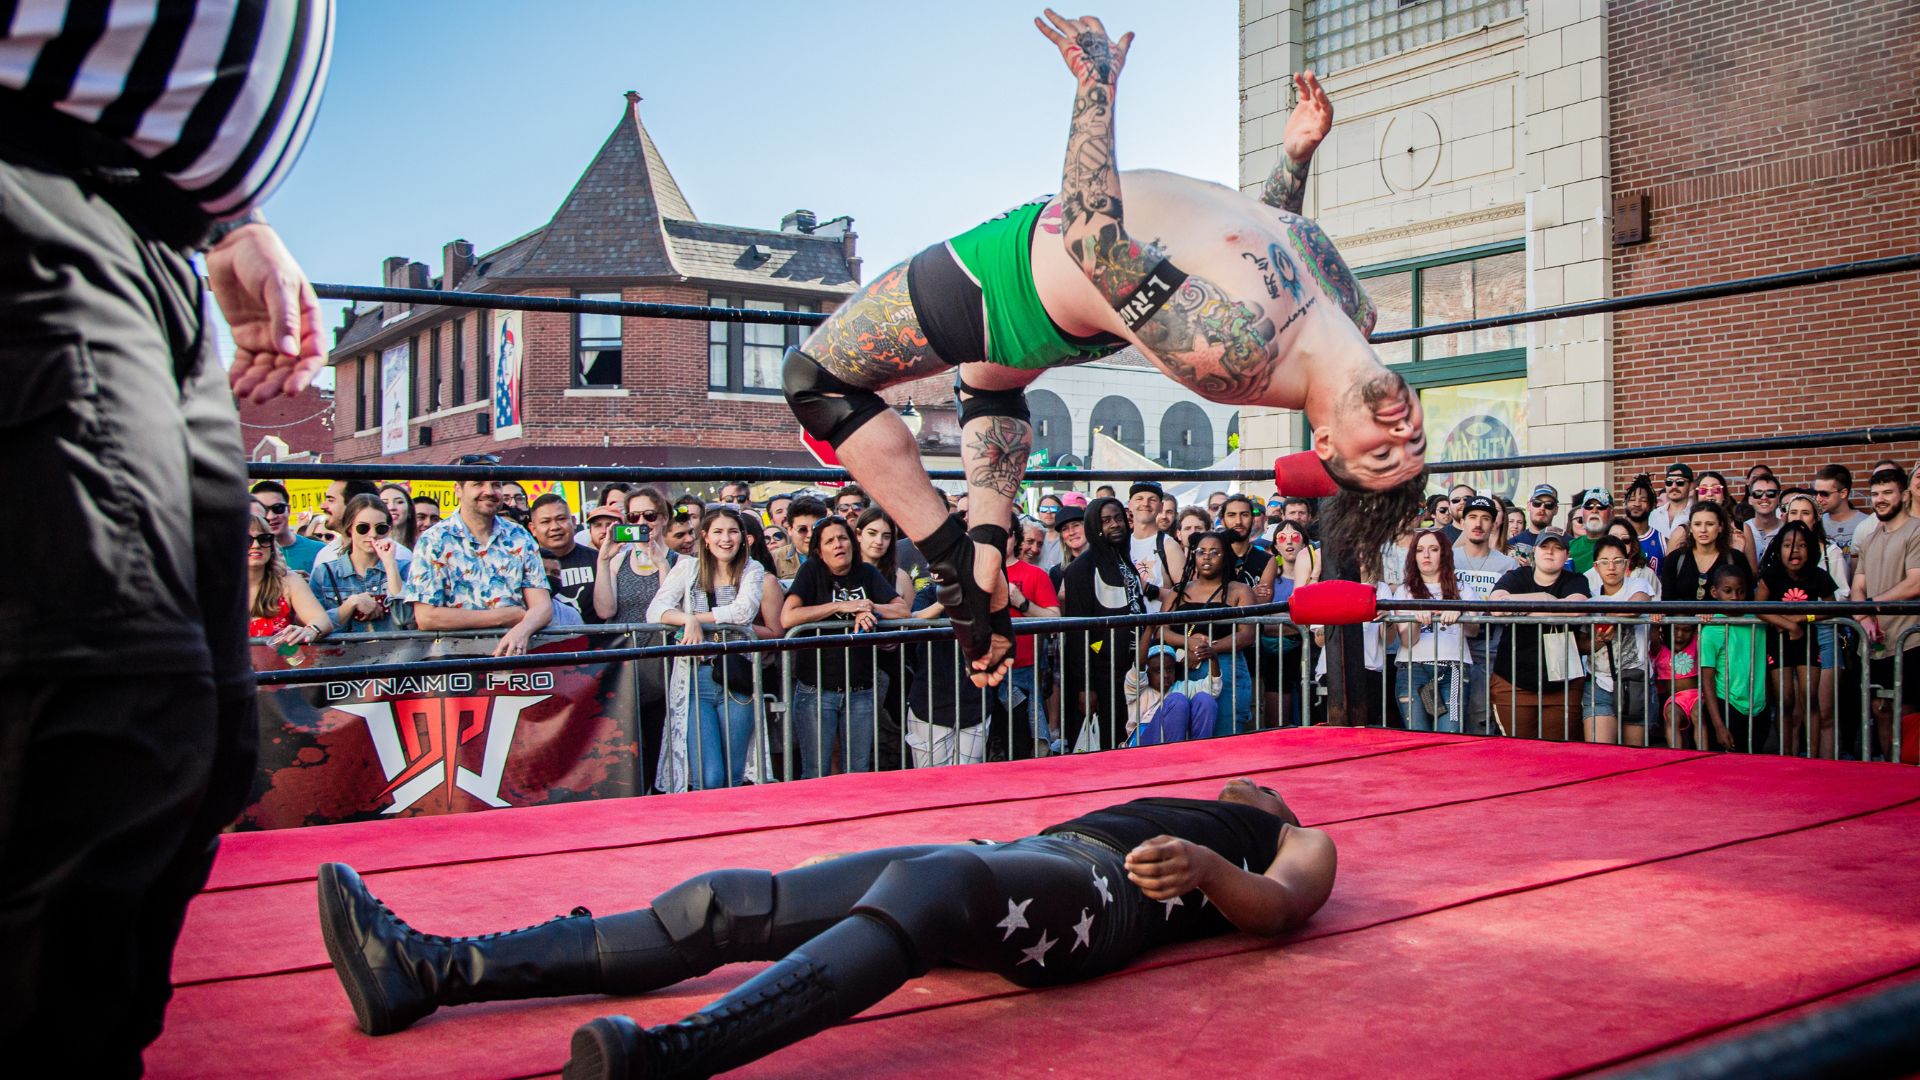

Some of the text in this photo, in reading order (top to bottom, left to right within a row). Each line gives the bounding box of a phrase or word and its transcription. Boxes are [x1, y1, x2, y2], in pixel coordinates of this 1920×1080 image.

[561, 566, 594, 588] MA
[1456, 571, 1495, 585] Corona
[1471, 585, 1487, 593] tra
[326, 672, 473, 700] DYNAMO
